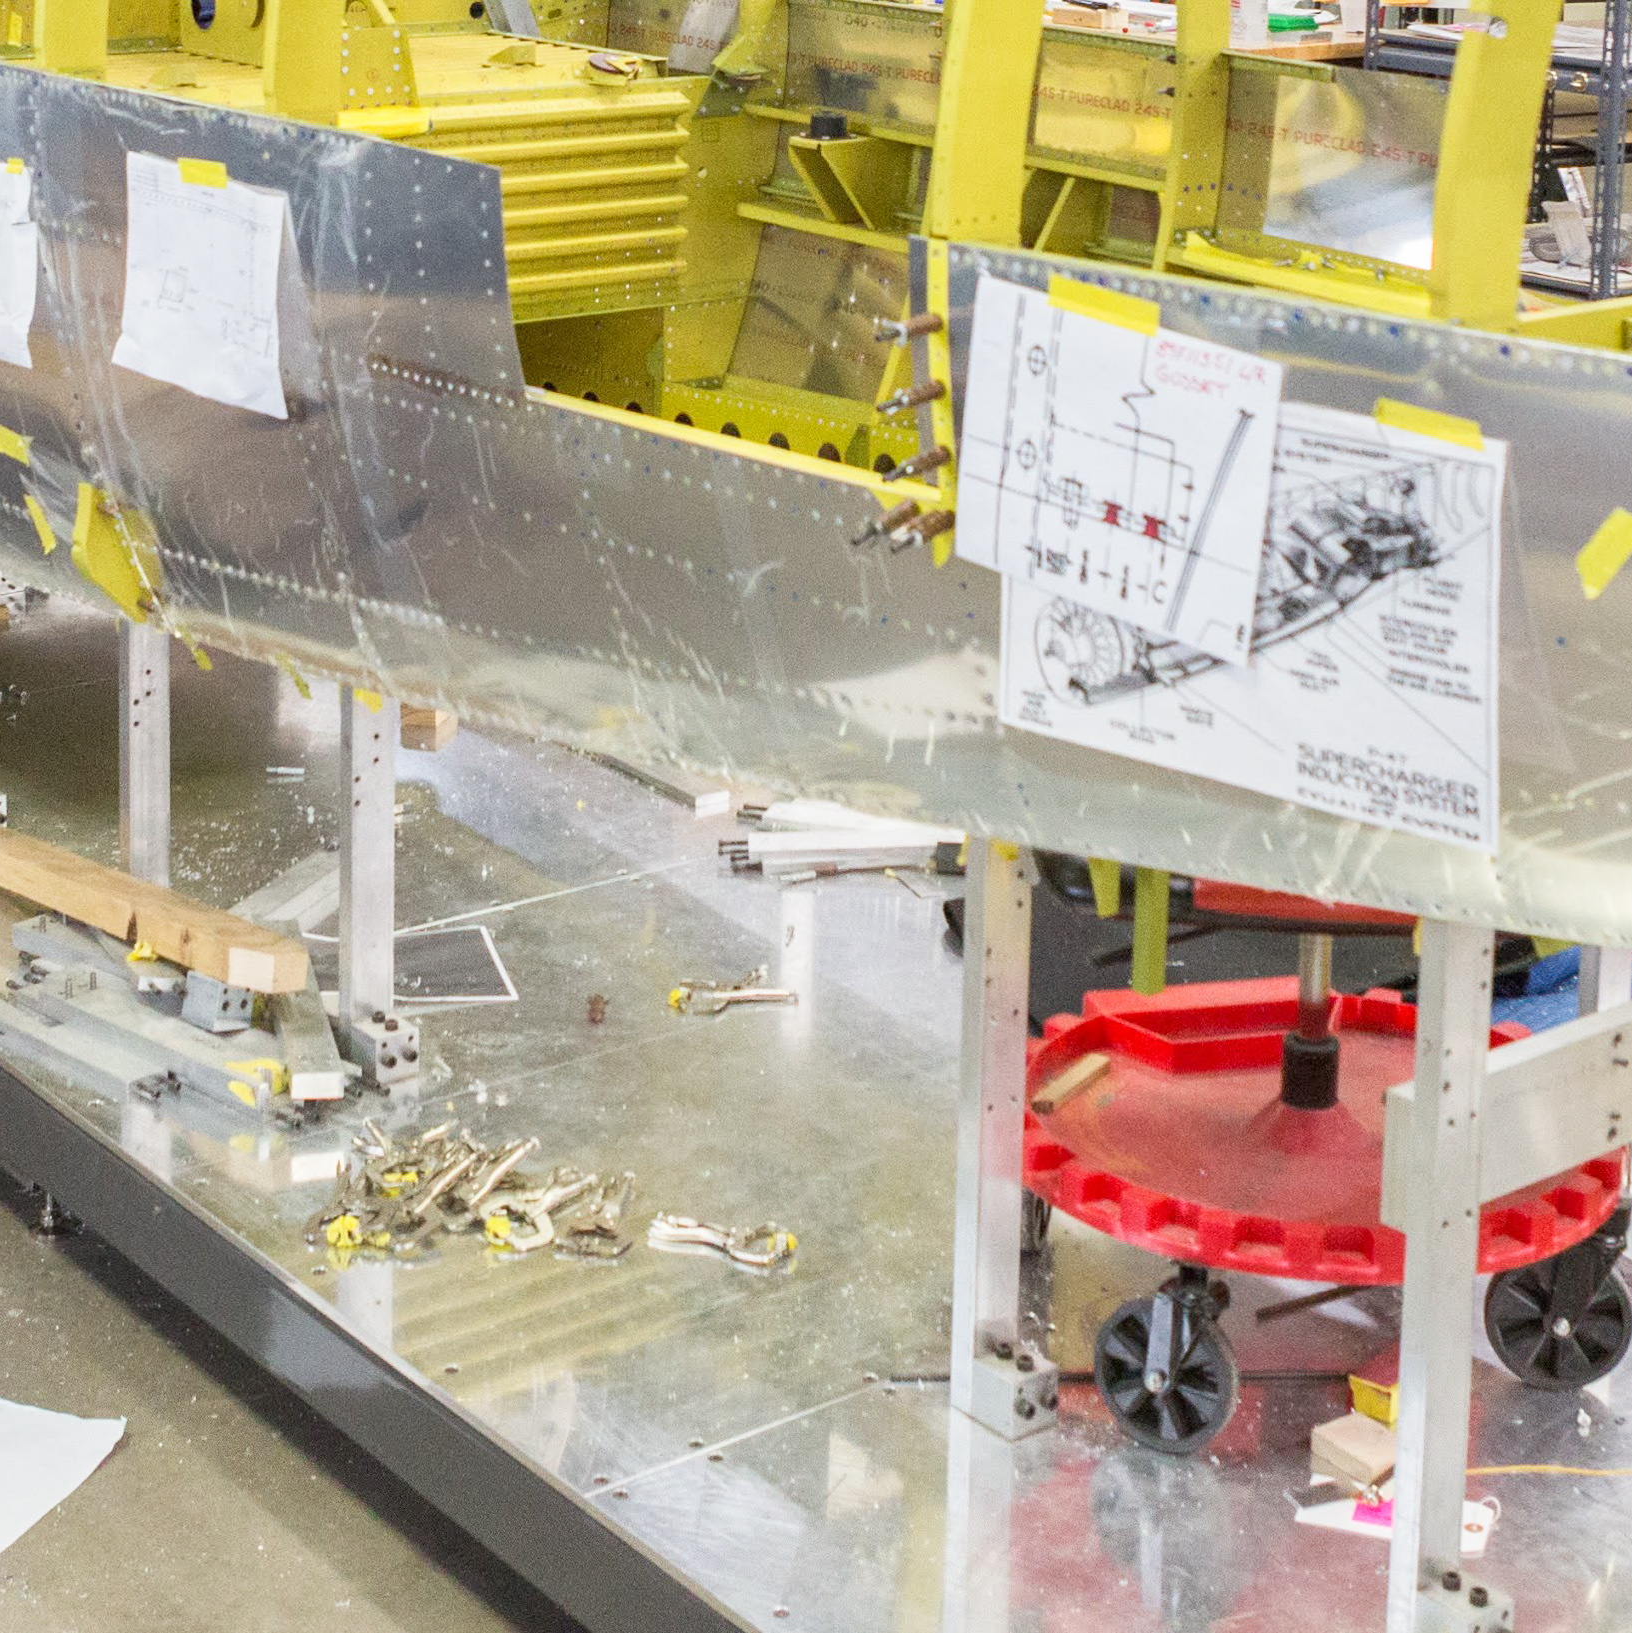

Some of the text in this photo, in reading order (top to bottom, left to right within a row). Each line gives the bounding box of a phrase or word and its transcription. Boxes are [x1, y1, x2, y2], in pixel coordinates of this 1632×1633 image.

[1069, 91, 1130, 113] PURECLAD
[1297, 742, 1478, 798] SUPERCHARGER
[1297, 761, 1479, 816] INDUCTION SYSTEM
